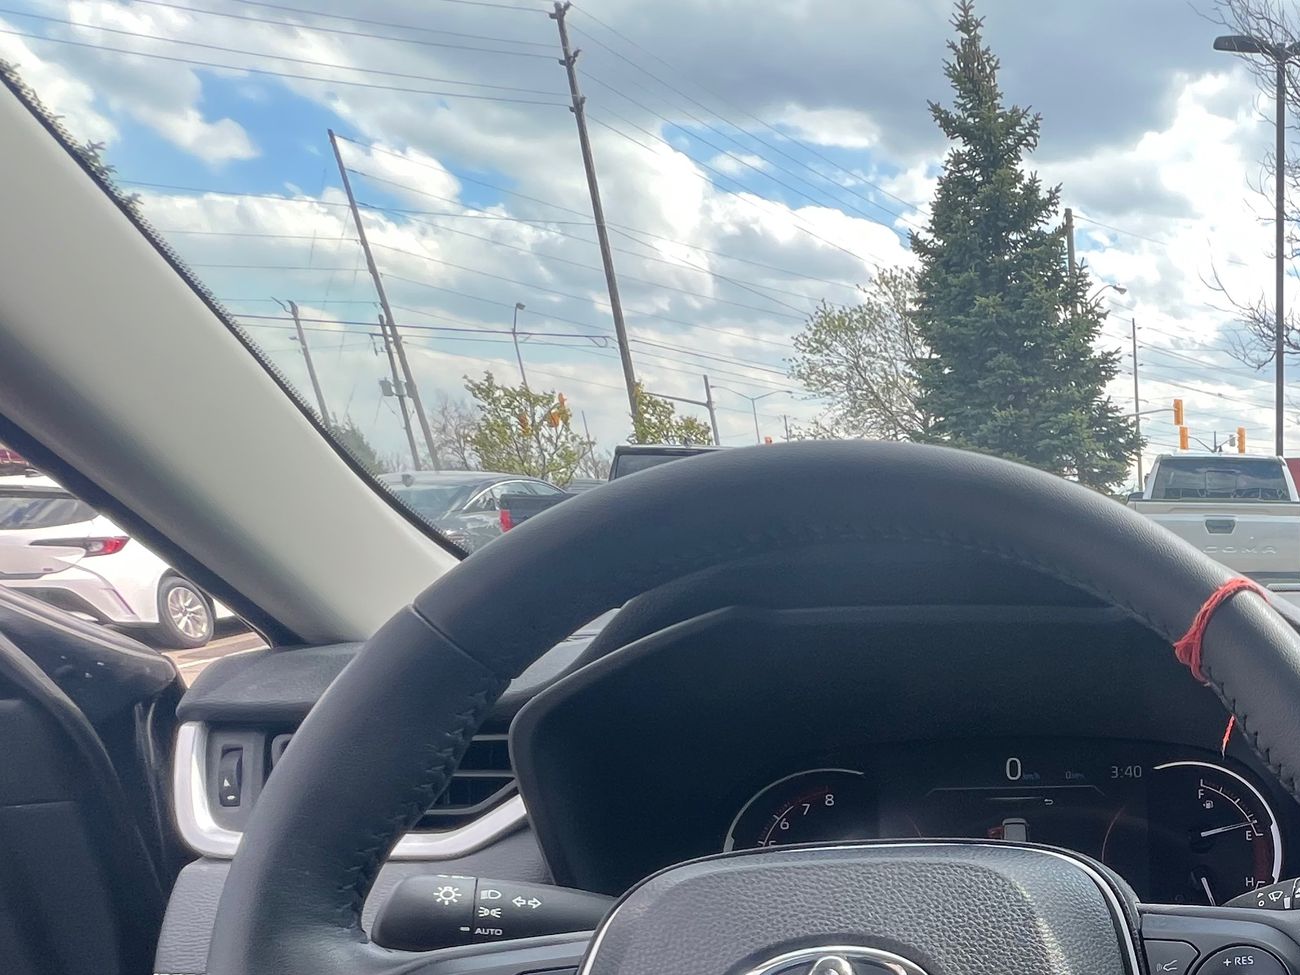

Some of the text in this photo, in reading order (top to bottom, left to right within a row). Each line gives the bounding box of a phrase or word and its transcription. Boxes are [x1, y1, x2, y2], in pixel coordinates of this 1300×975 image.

[1005, 757, 1022, 780] 0
[1111, 765, 1142, 779] 3:40
[1198, 789, 1204, 799] F
[825, 794, 834, 806] 8
[802, 803, 810, 815] 7
[780, 818, 789, 830] 6
[1246, 831, 1252, 840] E
[1246, 877, 1254, 887] H
[475, 927, 503, 936] AUTO
[1234, 956, 1254, 966] RES
